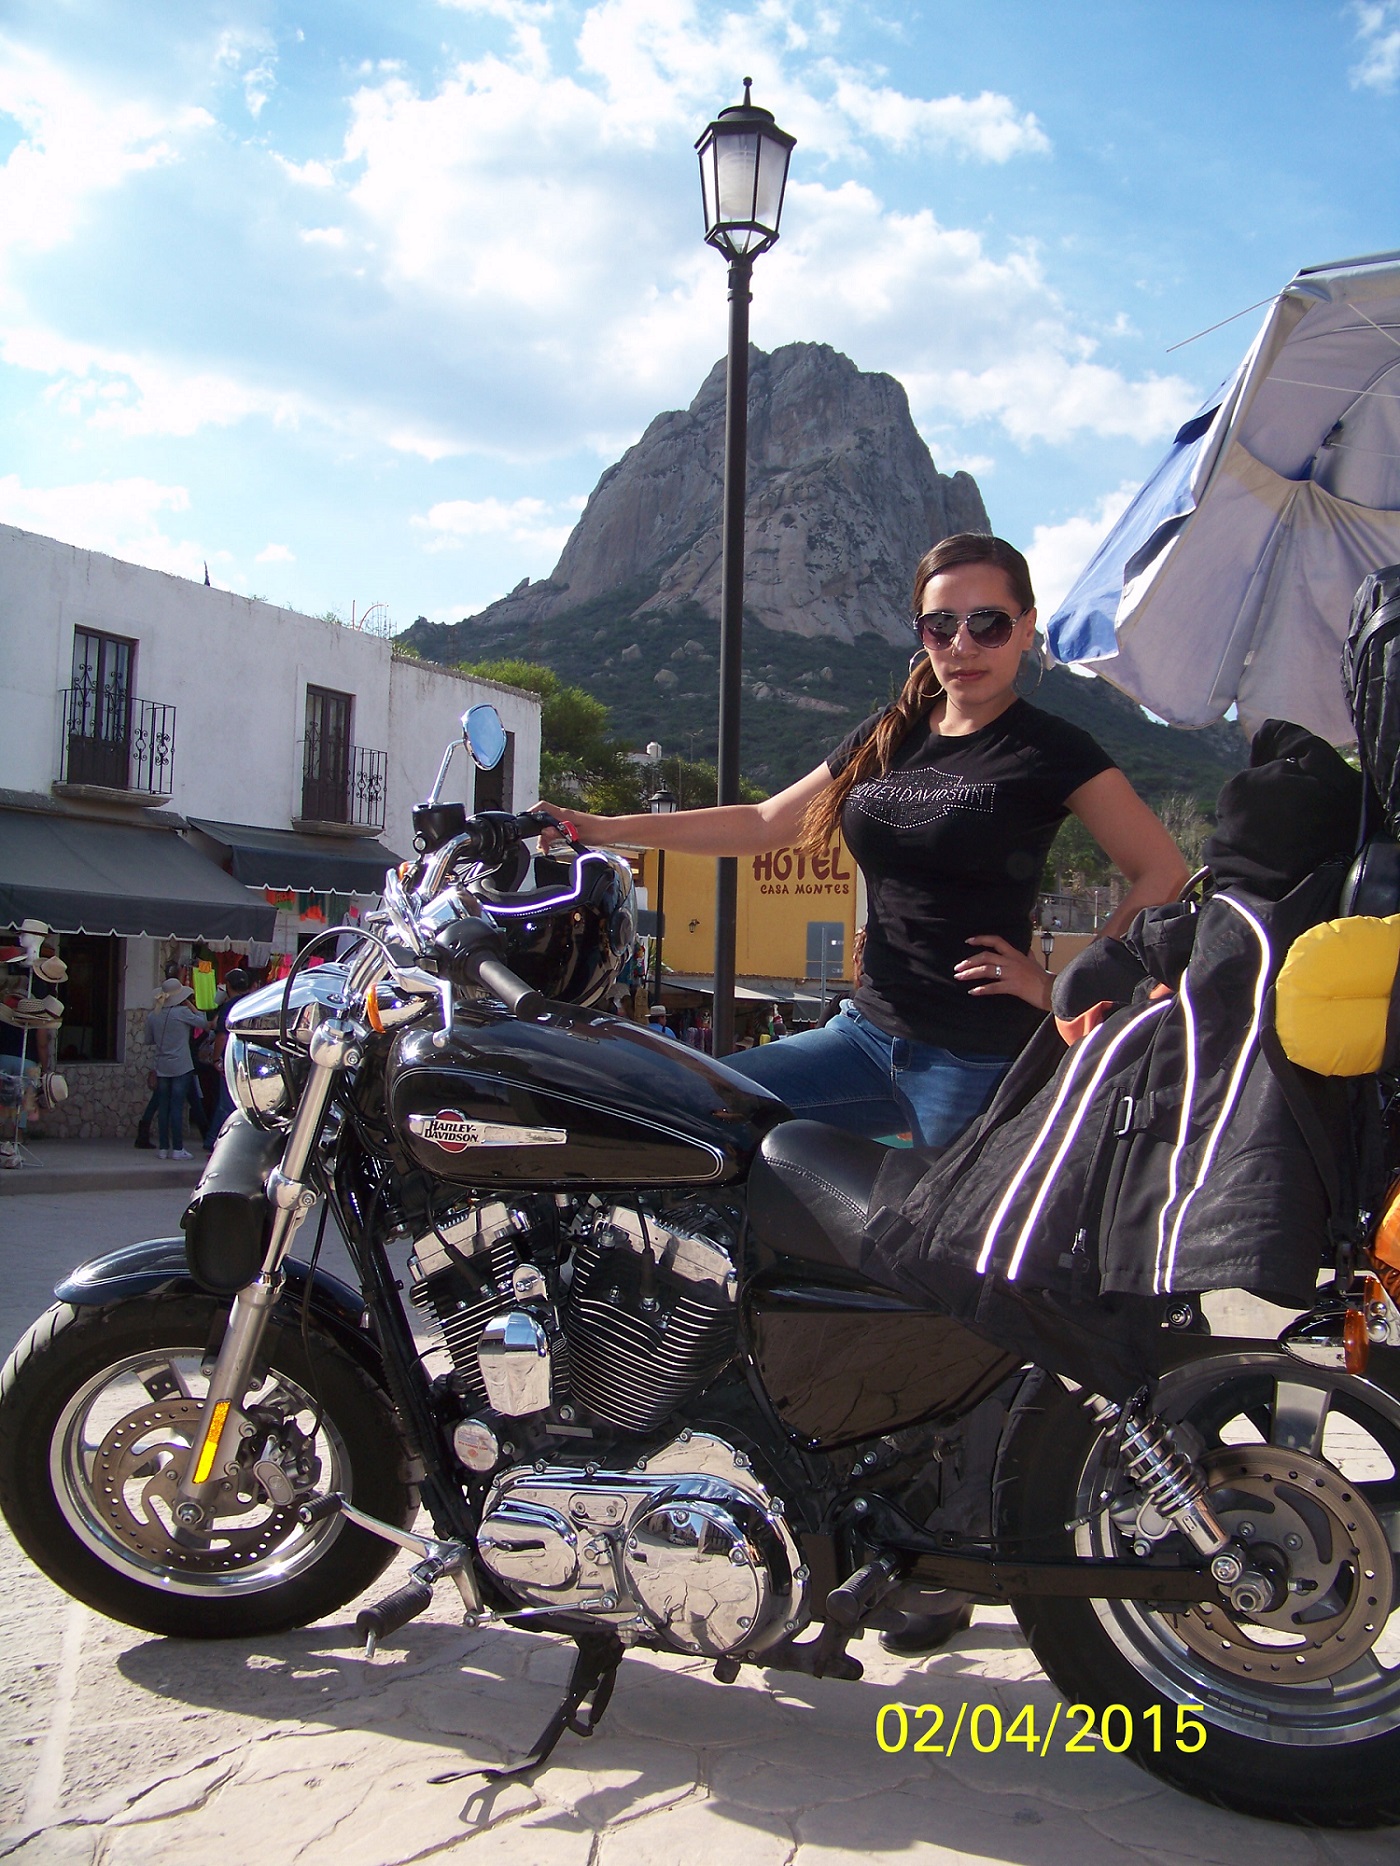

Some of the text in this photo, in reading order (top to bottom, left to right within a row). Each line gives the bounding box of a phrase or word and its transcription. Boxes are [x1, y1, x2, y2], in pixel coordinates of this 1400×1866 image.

[752, 847, 850, 880] HOTEL
[760, 884, 849, 894] CASA MONTES
[430, 1120, 477, 1133] HARLEY-
[425, 1128, 479, 1142] DAVIDSON
